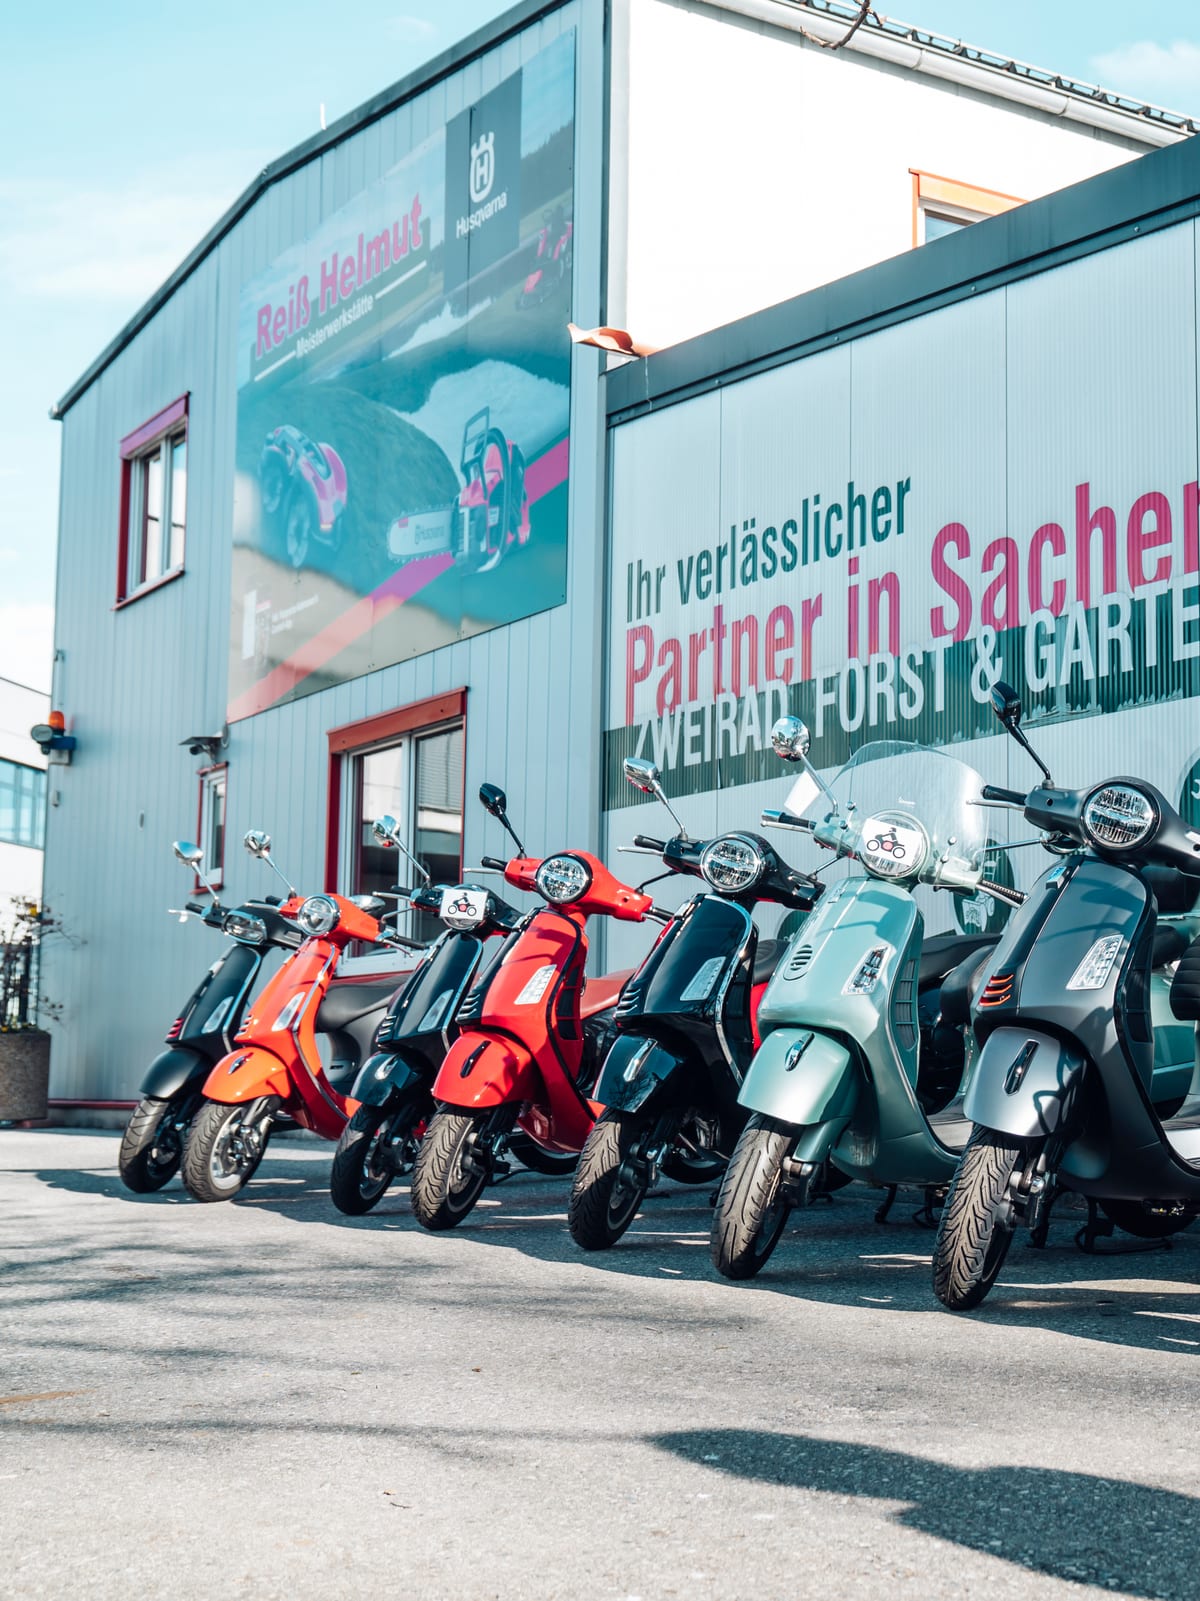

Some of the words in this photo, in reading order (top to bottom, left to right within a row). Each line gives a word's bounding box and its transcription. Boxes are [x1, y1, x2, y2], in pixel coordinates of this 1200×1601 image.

[256, 275, 311, 357] Reiß
[319, 192, 423, 315] Helmut
[456, 191, 507, 239] Husqvarna
[296, 294, 374, 358] Meisterwerkstätte
[626, 558, 666, 623] Ihr
[677, 476, 911, 605] verlässlicher
[625, 592, 822, 727] Partner
[847, 555, 901, 665] in
[812, 631, 955, 738] FORST
[970, 622, 1004, 703] &
